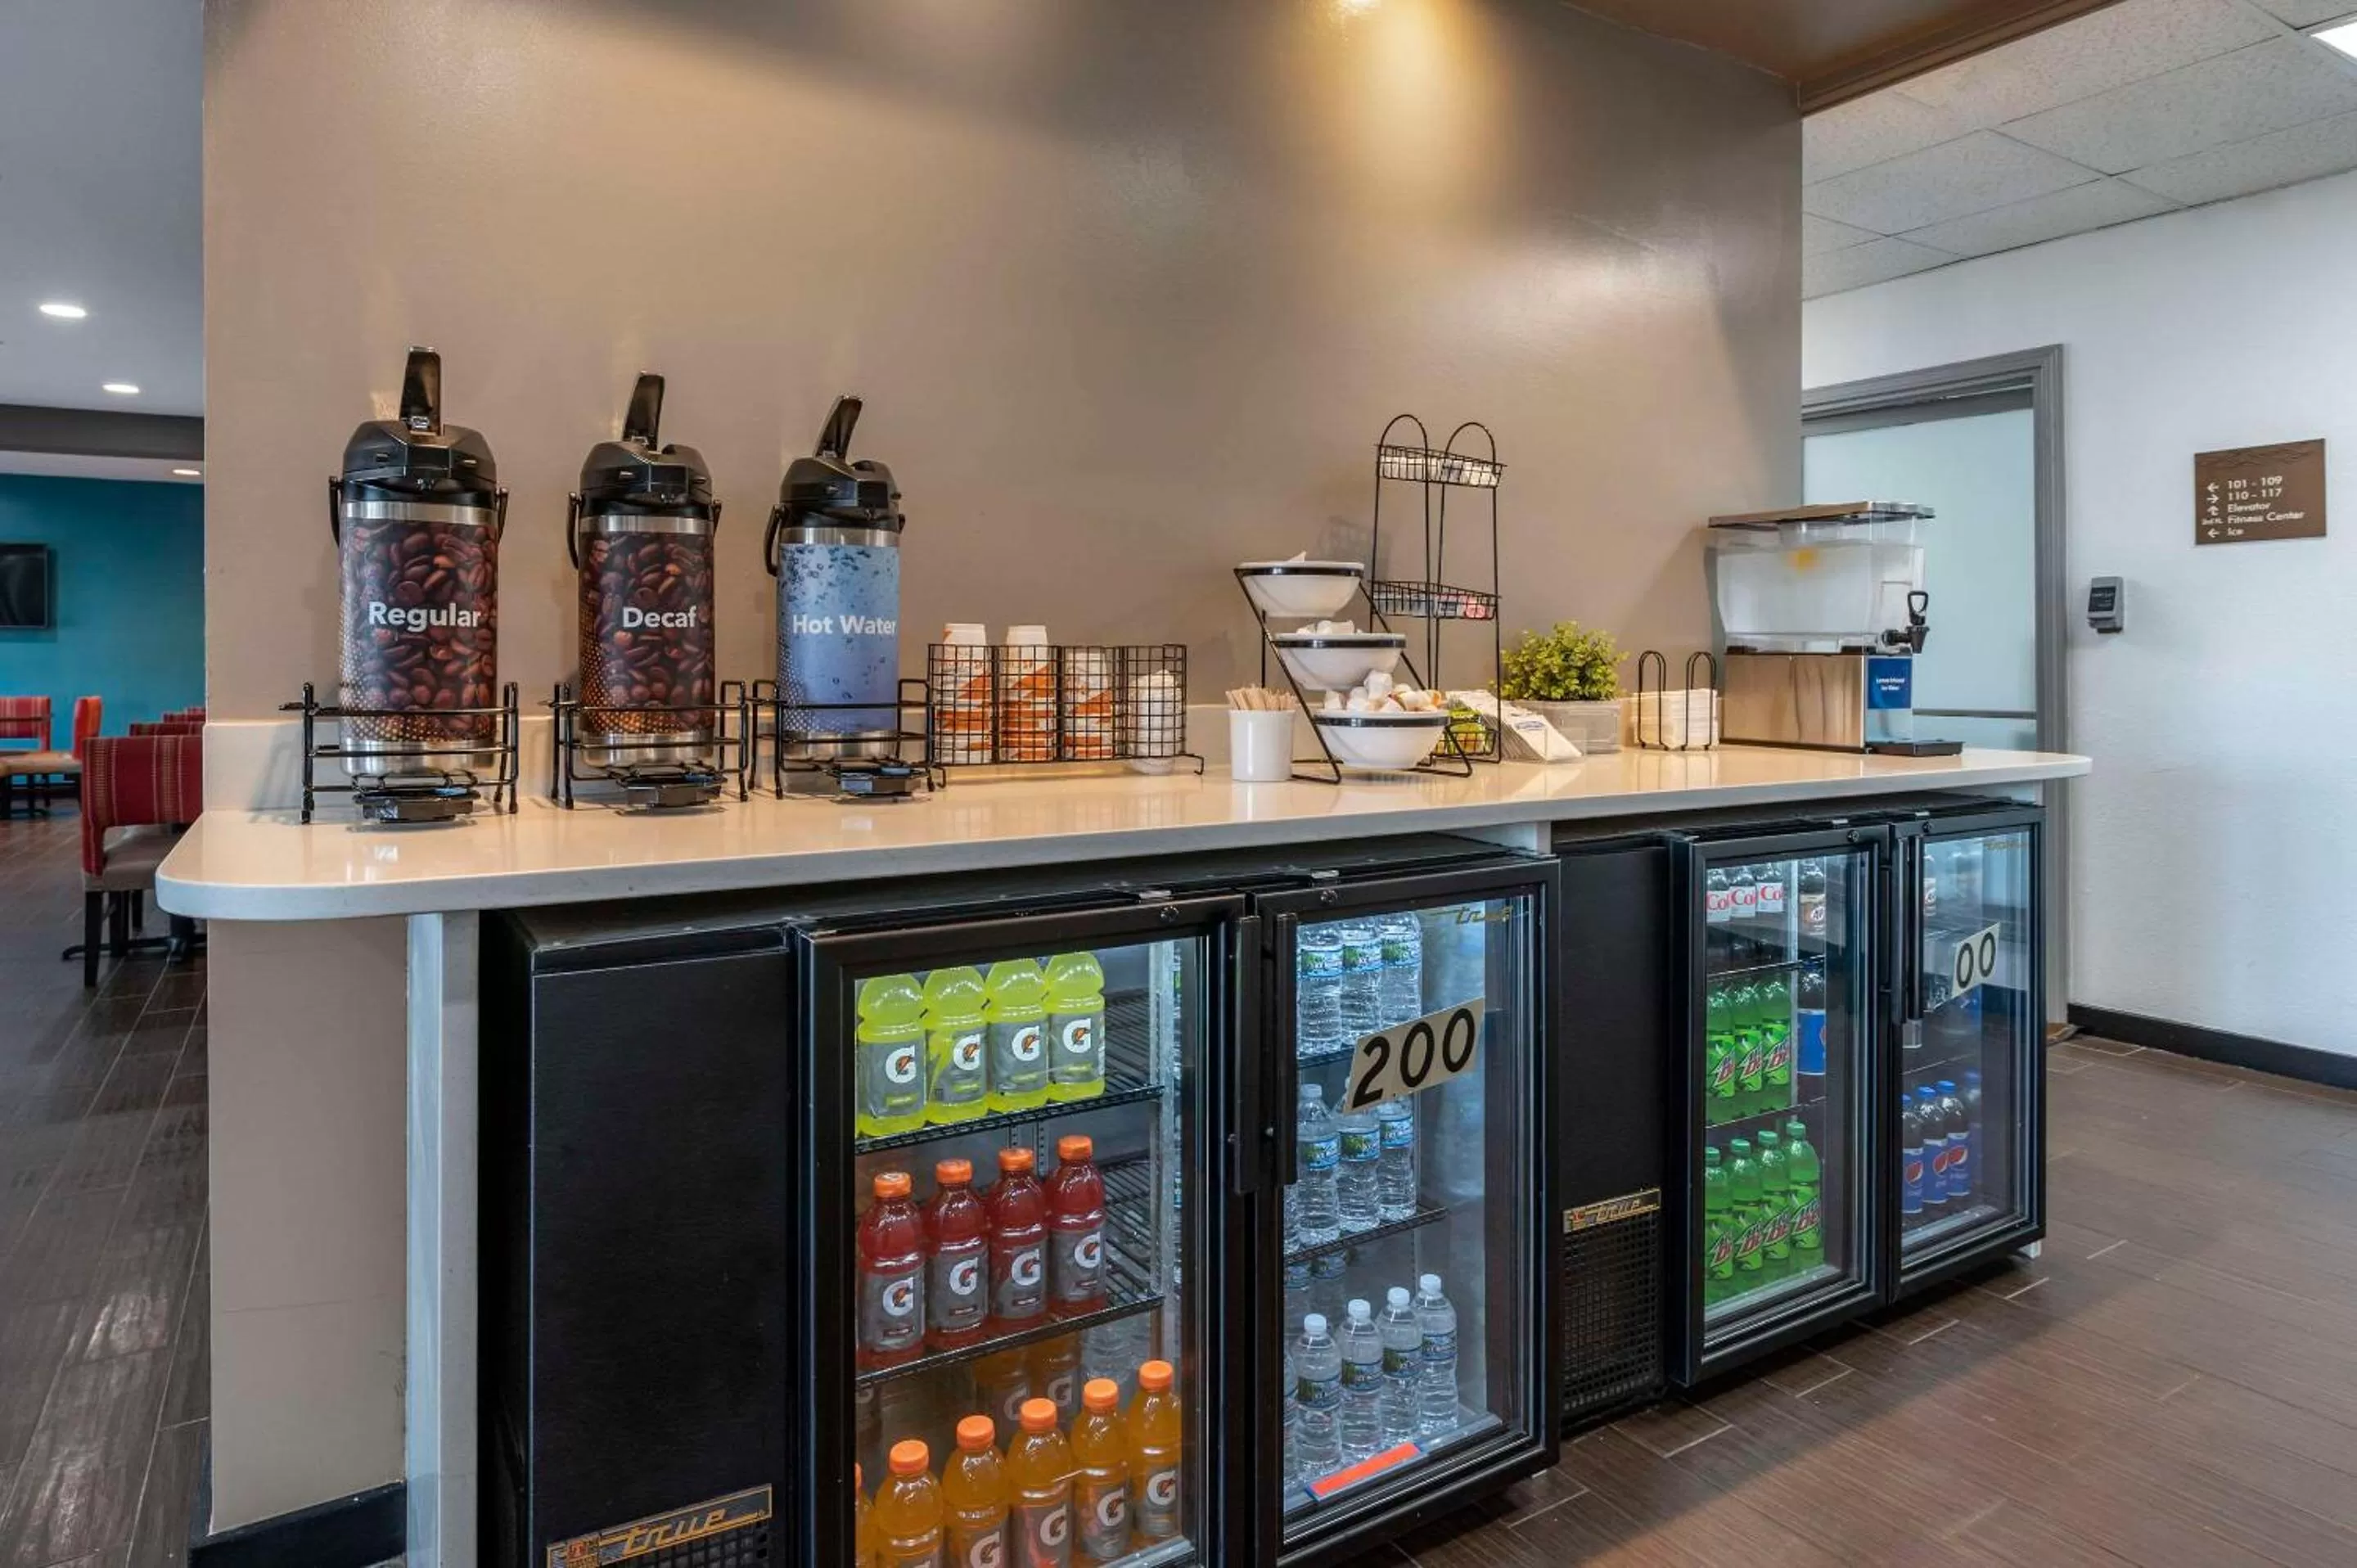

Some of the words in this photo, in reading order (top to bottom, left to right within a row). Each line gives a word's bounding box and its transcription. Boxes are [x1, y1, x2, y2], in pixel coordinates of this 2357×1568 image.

[2228, 480, 2247, 489] 101
[2261, 475, 2283, 487] 109
[2229, 491, 2249, 501] 110
[2261, 488, 2282, 498] 117
[2228, 502, 2271, 513] Elevator
[2228, 516, 2264, 524] Fitness
[2266, 511, 2305, 521] Center
[2228, 527, 2244, 536] Ice
[368, 601, 481, 633] Regular
[623, 605, 697, 628] Decaf
[792, 614, 834, 634] Hot
[839, 615, 897, 635] Water
[1956, 931, 1996, 989] 00
[953, 1034, 981, 1070] G
[1012, 1025, 1040, 1061] G
[1062, 1018, 1091, 1053] G
[886, 1044, 917, 1084] G
[1352, 1007, 1475, 1108] 200
[1012, 1249, 1041, 1286] G
[1074, 1232, 1101, 1268] G
[949, 1257, 979, 1295] G
[882, 1277, 914, 1316] G
[623, 1508, 727, 1556] true
